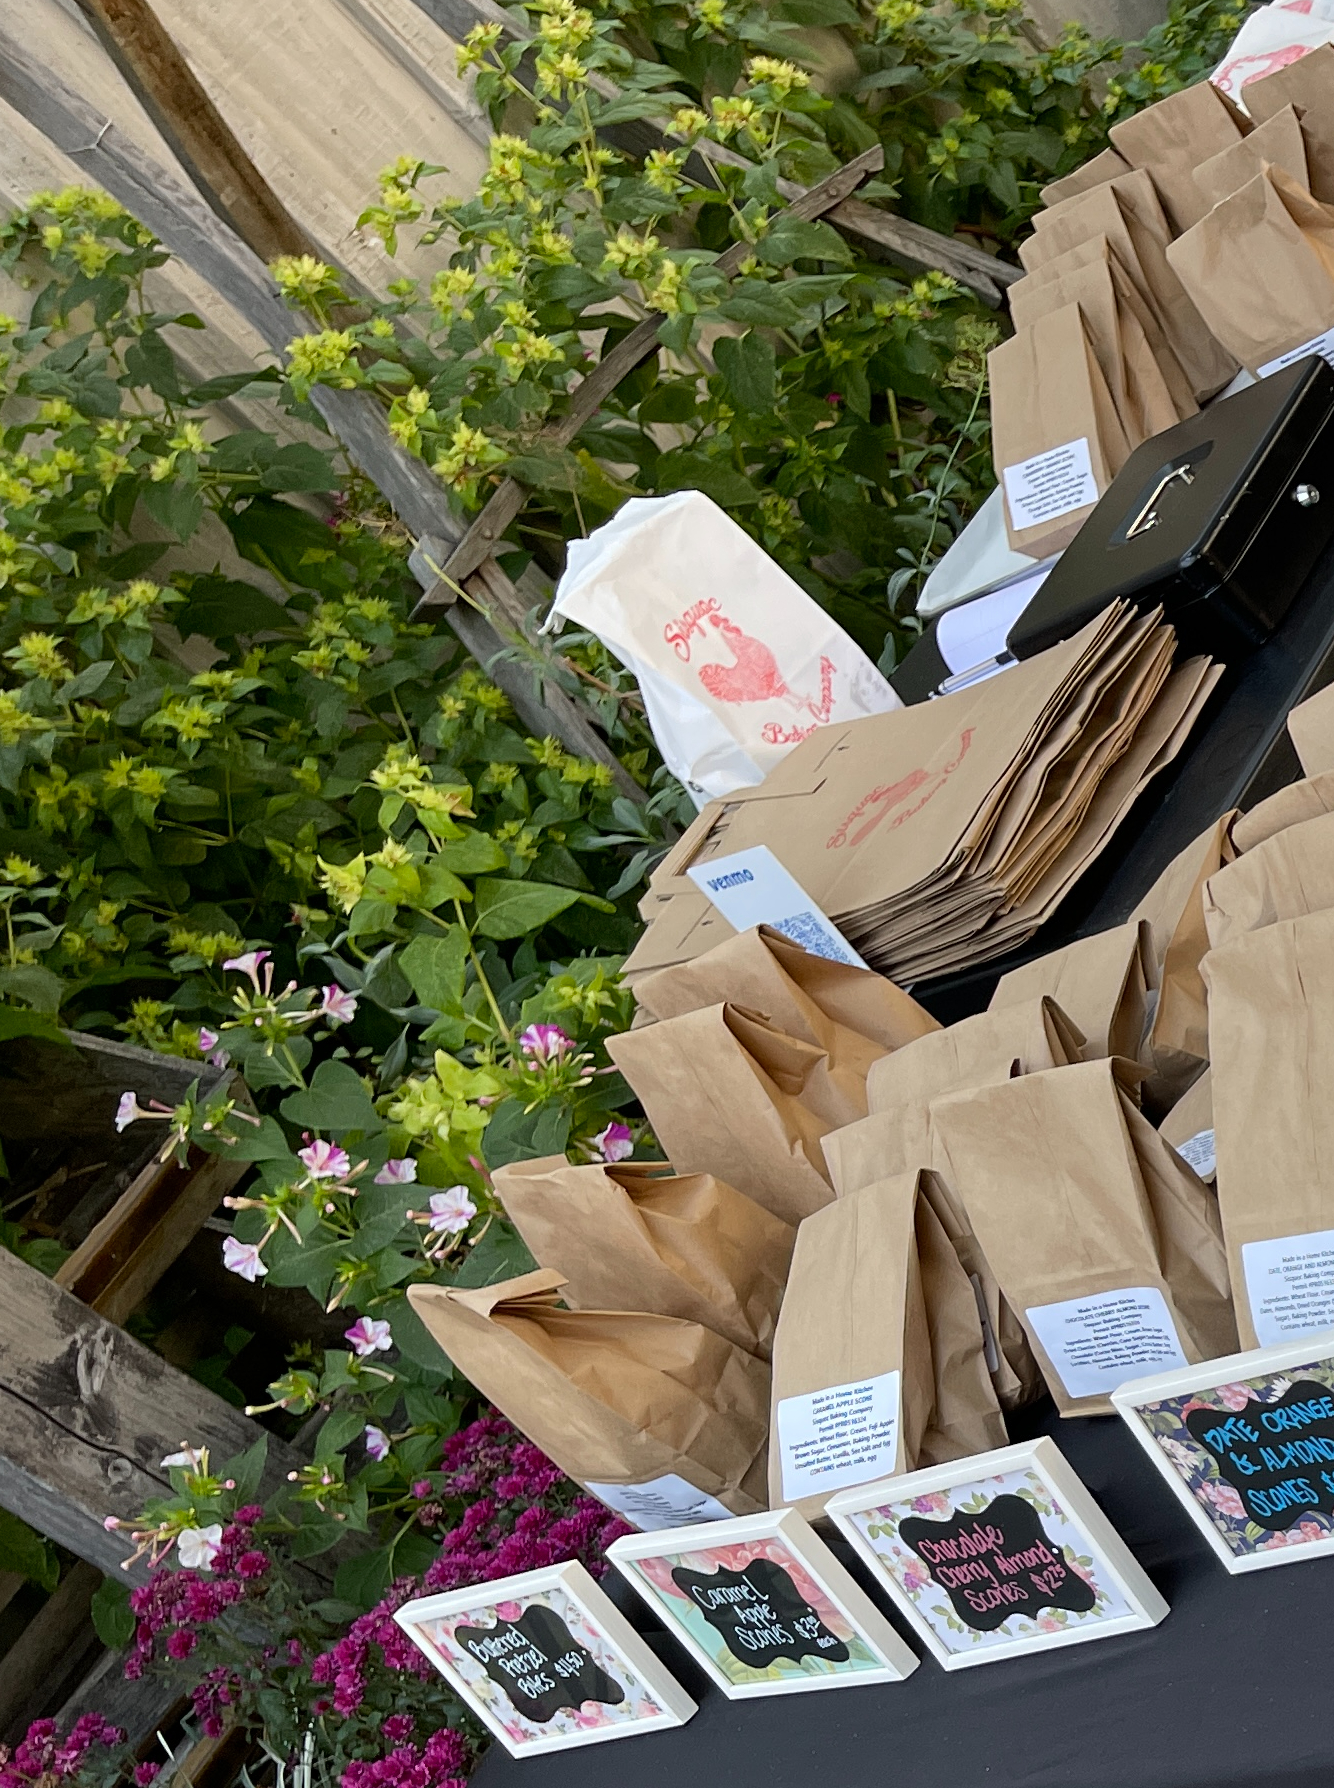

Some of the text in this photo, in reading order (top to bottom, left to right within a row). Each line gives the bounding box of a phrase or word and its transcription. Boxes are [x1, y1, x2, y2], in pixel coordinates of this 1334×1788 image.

[706, 868, 755, 892] venmo
[1203, 1417, 1260, 1454] DATE
[1229, 1452, 1262, 1475] &
[1247, 1478, 1319, 1517] SCONES
[918, 1522, 1004, 1564] Chocolate
[936, 1539, 1056, 1589] Cherry Almond
[692, 1575, 769, 1610] Caramel
[964, 1582, 1029, 1613] Scones
[733, 1603, 777, 1628] Apple
[735, 1623, 795, 1651] Scones
[498, 1644, 549, 1678] Pretzel
